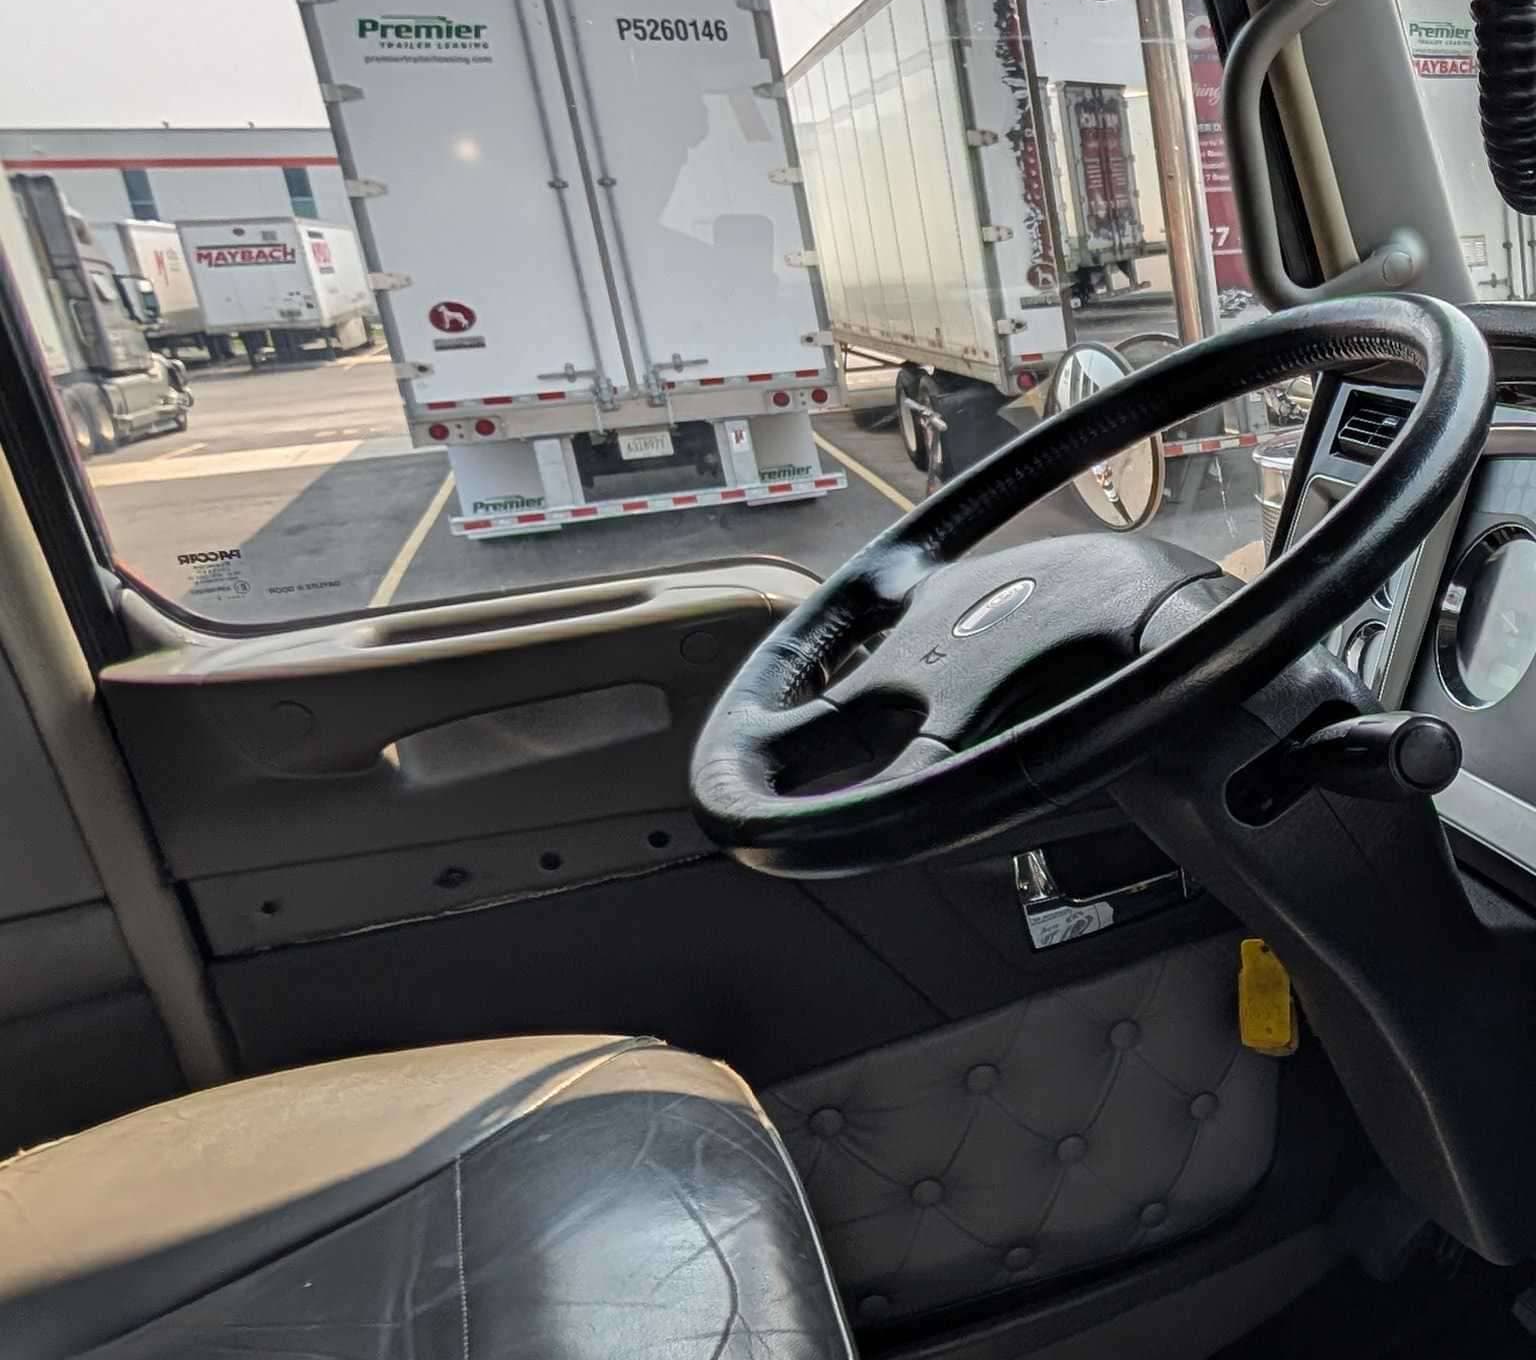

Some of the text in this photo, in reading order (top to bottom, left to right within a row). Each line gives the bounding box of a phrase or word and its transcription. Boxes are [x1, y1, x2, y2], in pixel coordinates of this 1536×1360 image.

[357, 15, 487, 39] Premier
[616, 18, 728, 41] P5260146
[1409, 22, 1473, 39] Premier
[196, 244, 296, 268] MAYBACH
[760, 465, 812, 481] remier
[473, 496, 545, 514] Premier
